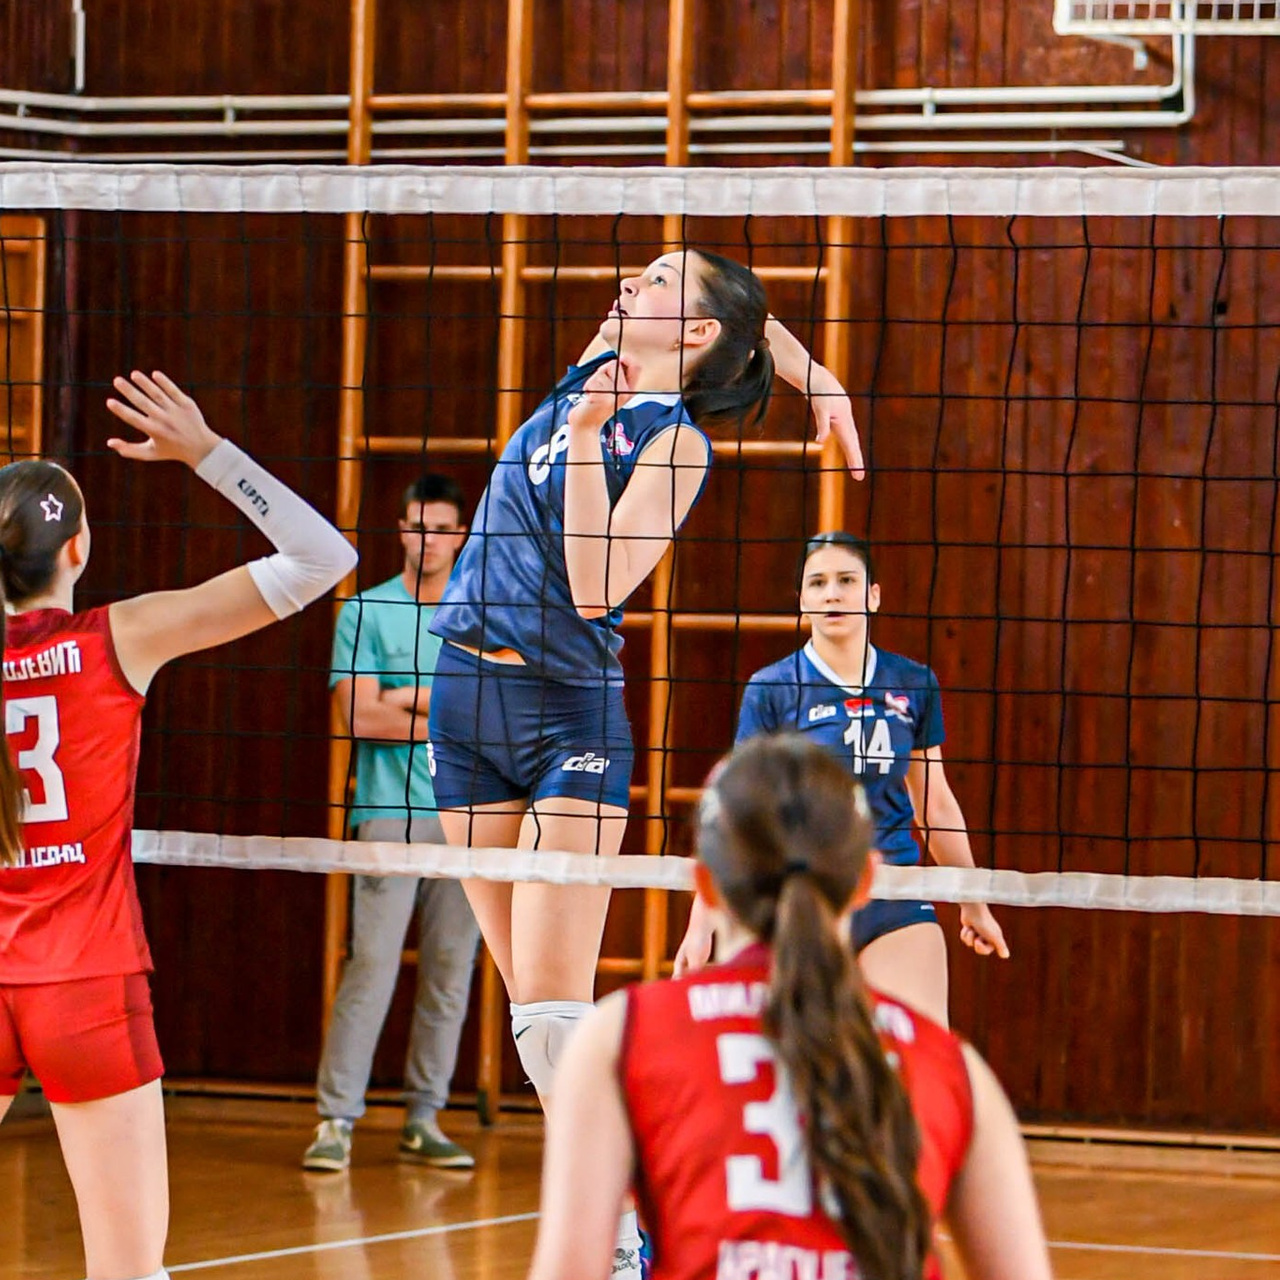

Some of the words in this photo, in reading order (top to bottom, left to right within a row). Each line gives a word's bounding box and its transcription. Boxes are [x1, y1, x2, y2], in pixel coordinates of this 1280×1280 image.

[237, 478, 269, 517] KIPSTA
[4, 694, 70, 824] 3
[843, 718, 896, 775] 14
